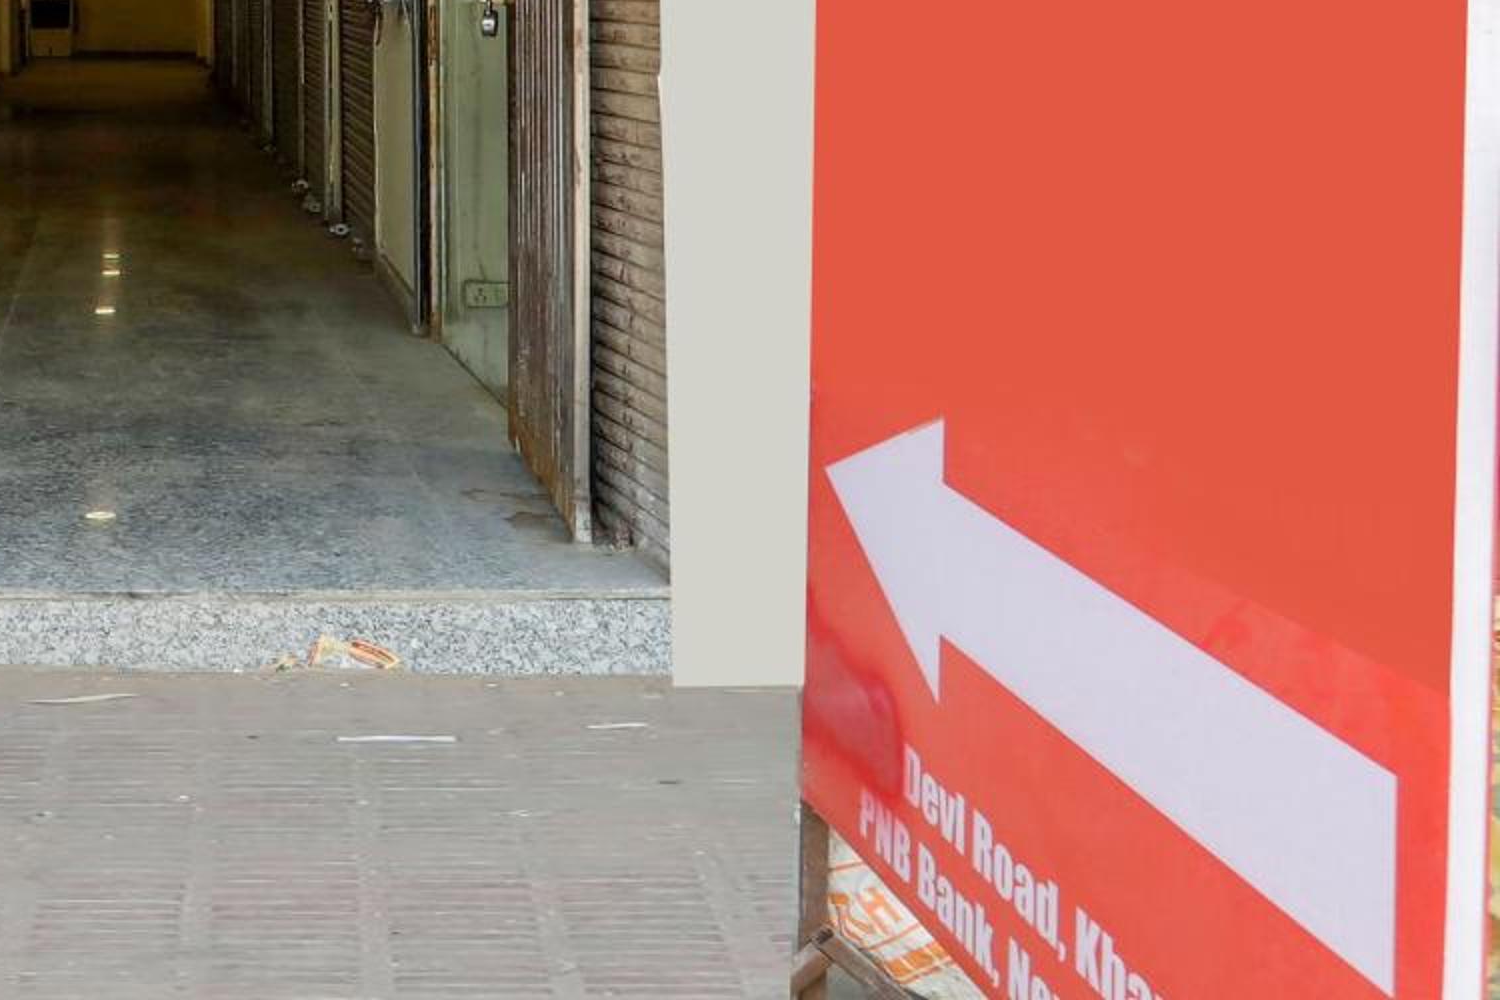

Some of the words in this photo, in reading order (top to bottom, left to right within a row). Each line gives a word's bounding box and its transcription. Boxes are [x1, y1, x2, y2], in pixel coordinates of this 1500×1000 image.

[860, 785, 911, 885] PNB
[917, 840, 1000, 989] Bank,
[972, 807, 1067, 962] Road,
